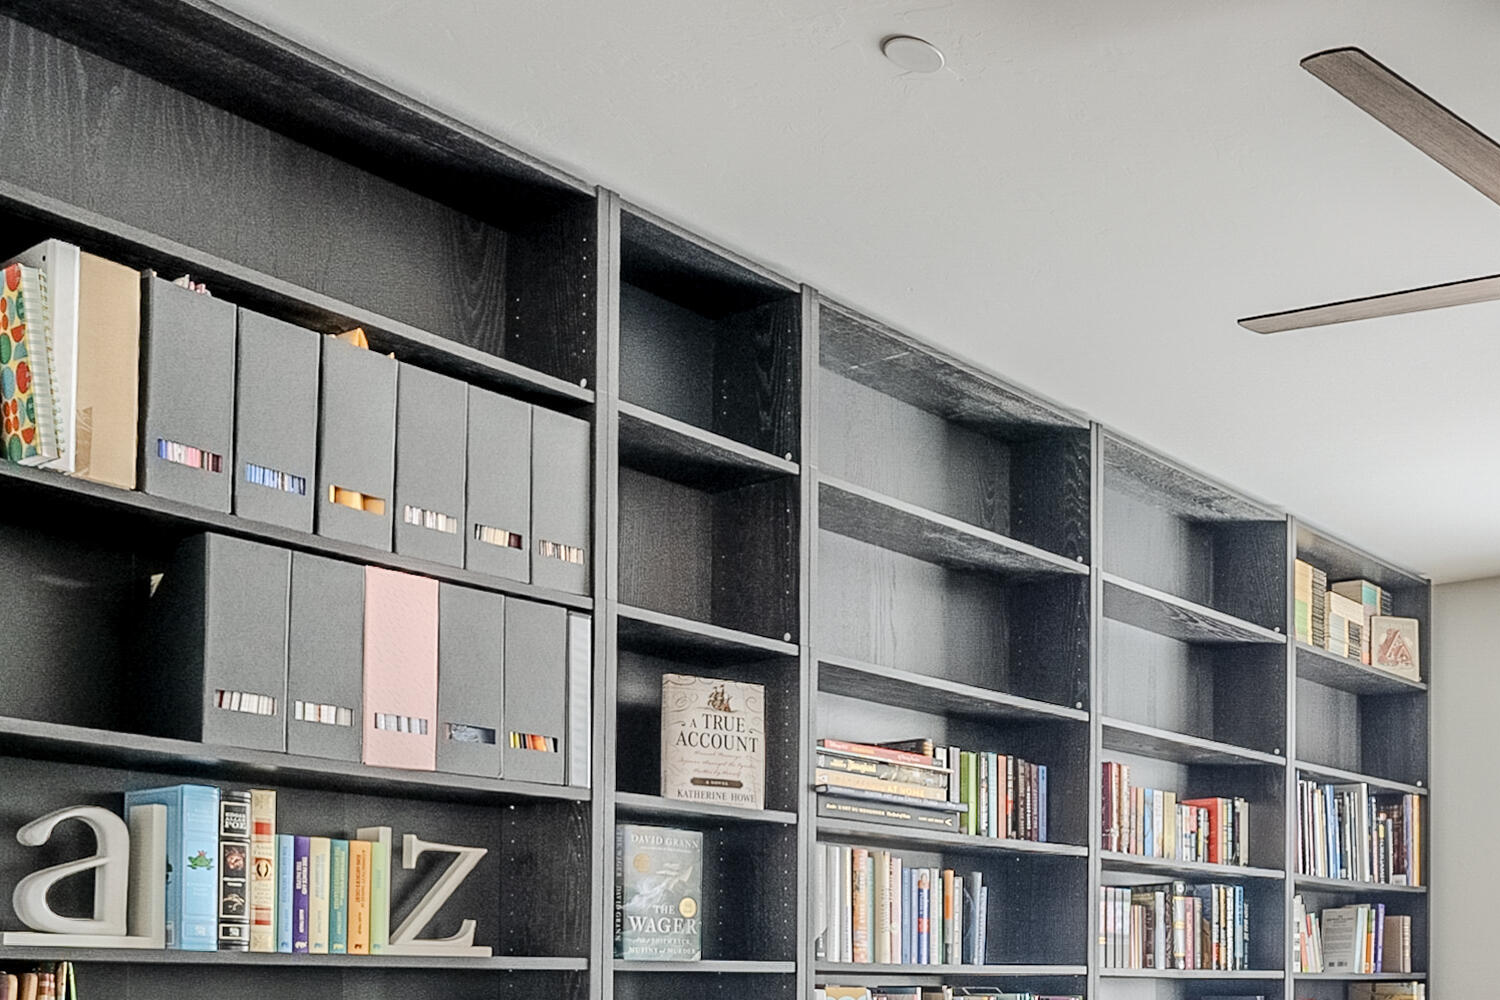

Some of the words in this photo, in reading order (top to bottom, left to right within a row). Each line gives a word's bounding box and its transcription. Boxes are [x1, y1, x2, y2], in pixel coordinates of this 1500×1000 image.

[690, 718, 698, 728] A
[702, 713, 744, 733] TRUE
[676, 732, 758, 752] ACCOUNT
[678, 788, 728, 800] KATHERINE
[731, 793, 756, 804] HOWE
[631, 834, 663, 845] DAVID
[666, 838, 699, 848] GRANN
[654, 905, 676, 914] THE
[628, 916, 698, 934] WAGER
